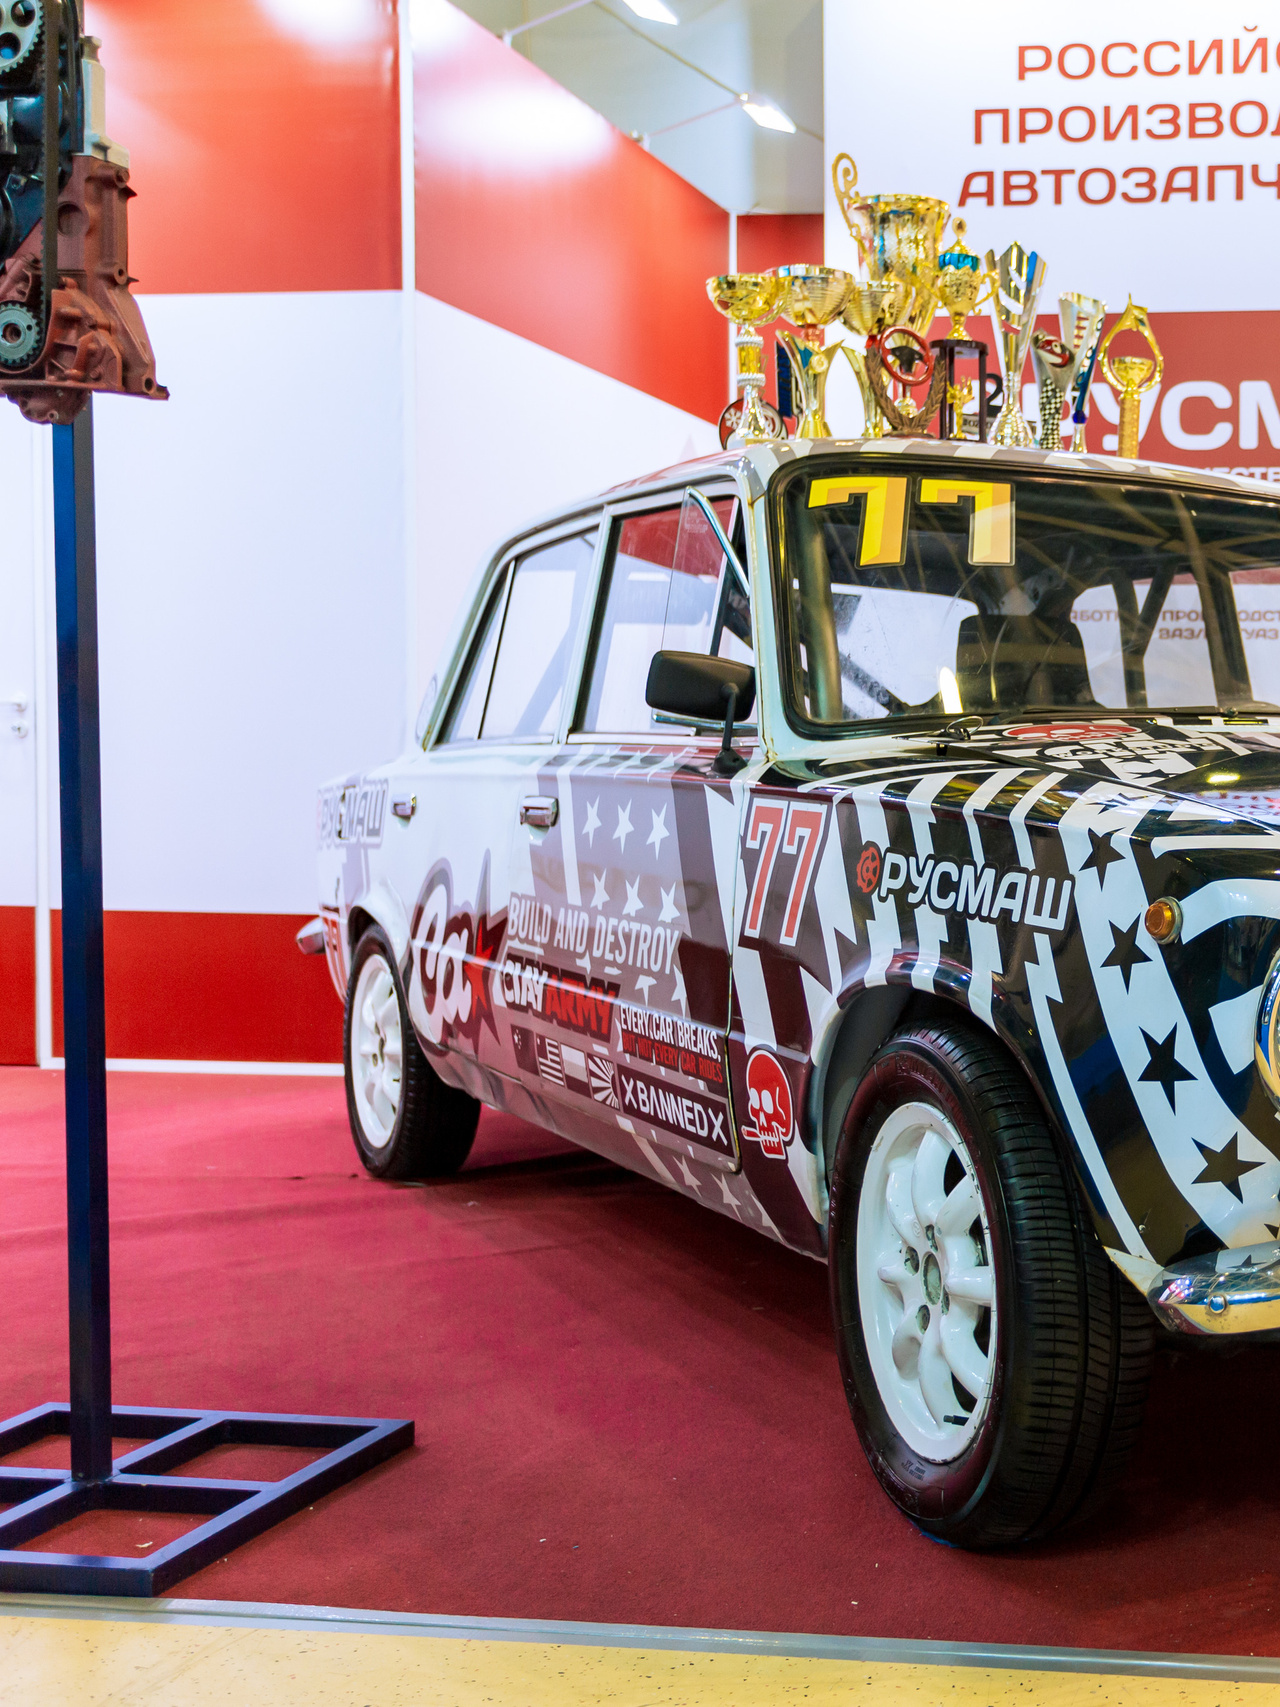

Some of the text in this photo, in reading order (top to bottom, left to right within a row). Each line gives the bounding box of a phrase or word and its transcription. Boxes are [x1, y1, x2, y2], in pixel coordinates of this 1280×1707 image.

[807, 475, 1012, 568] 77
[743, 797, 827, 946] 77
[880, 850, 1077, 931] РУСМАШ
[507, 896, 680, 975] BUILD AND DESTROY
[545, 973, 617, 1035] ARMY
[620, 1003, 651, 1036] EVERY
[652, 1012, 675, 1046] CAR
[654, 1042, 679, 1068] EVERY
[681, 1051, 697, 1075] CAR
[699, 1057, 724, 1084] RIDES
